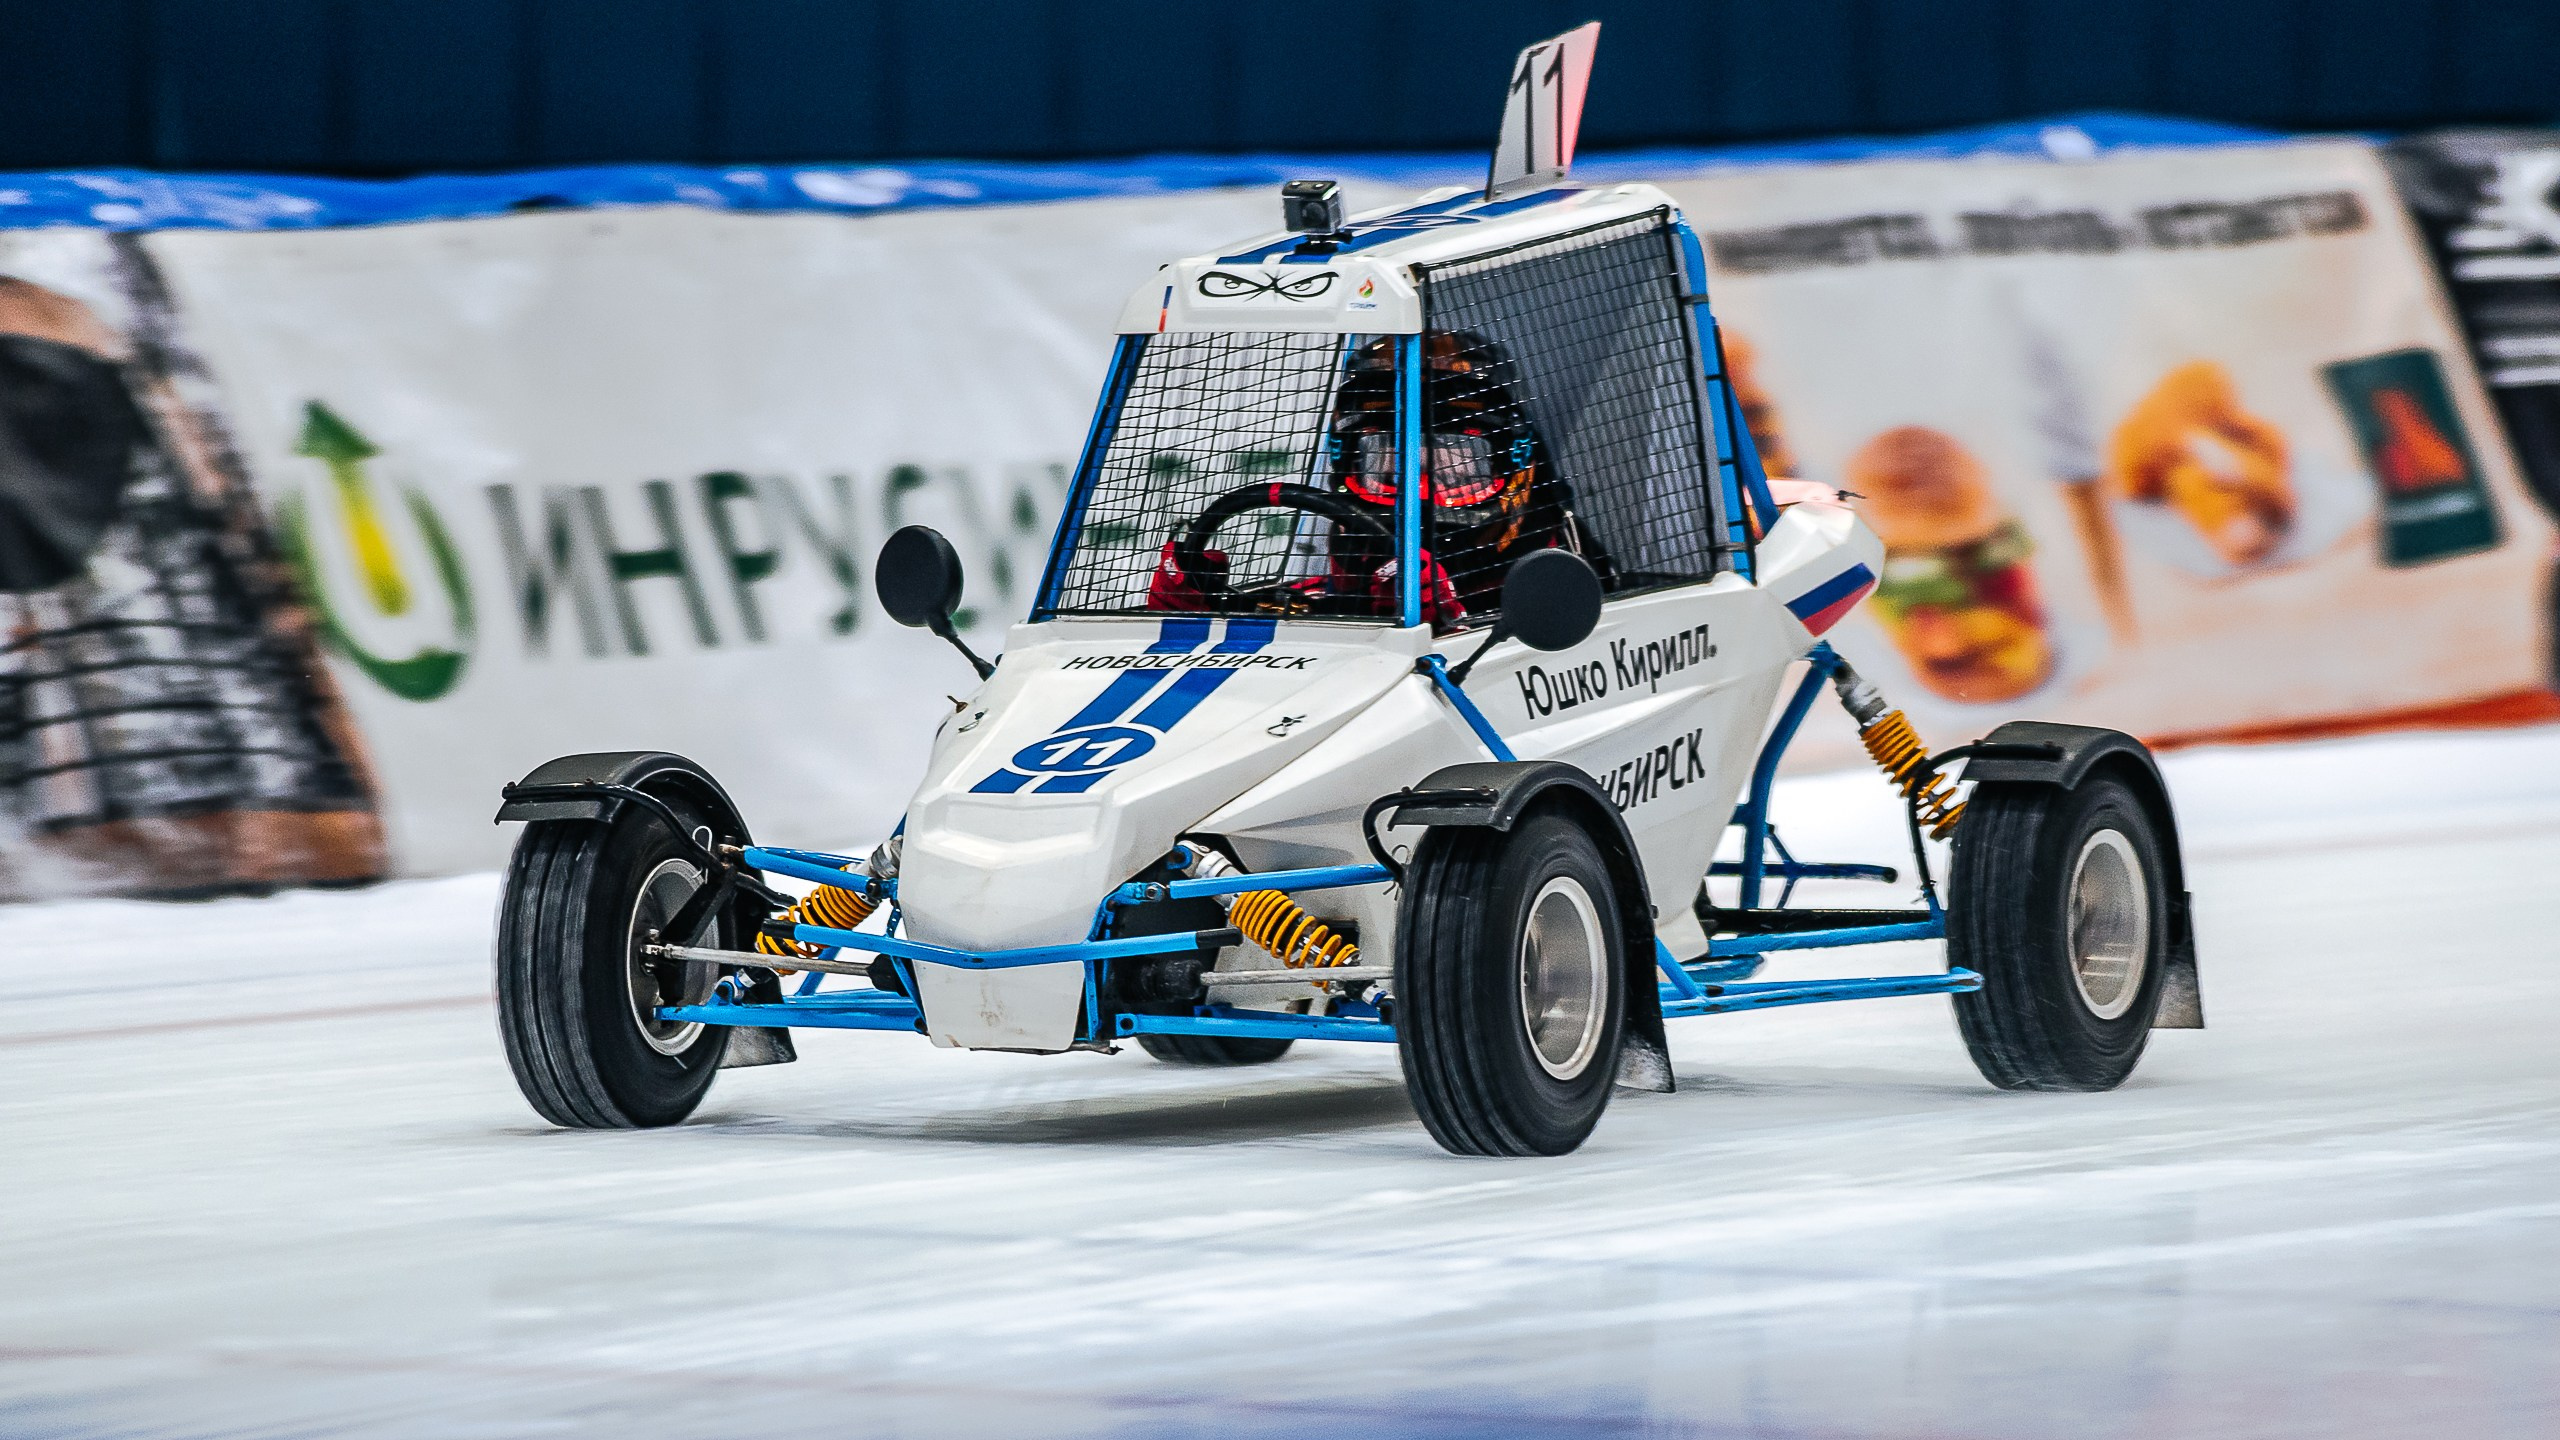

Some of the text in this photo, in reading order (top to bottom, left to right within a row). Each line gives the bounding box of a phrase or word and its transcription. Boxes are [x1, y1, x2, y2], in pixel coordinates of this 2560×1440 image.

[1511, 43, 1565, 175] 11
[1061, 654, 1319, 670] НОВОСИБИРСК
[1514, 664, 1608, 720] Юшко
[1039, 737, 1135, 766] 11
[1600, 727, 1706, 814] ИБИРСК
